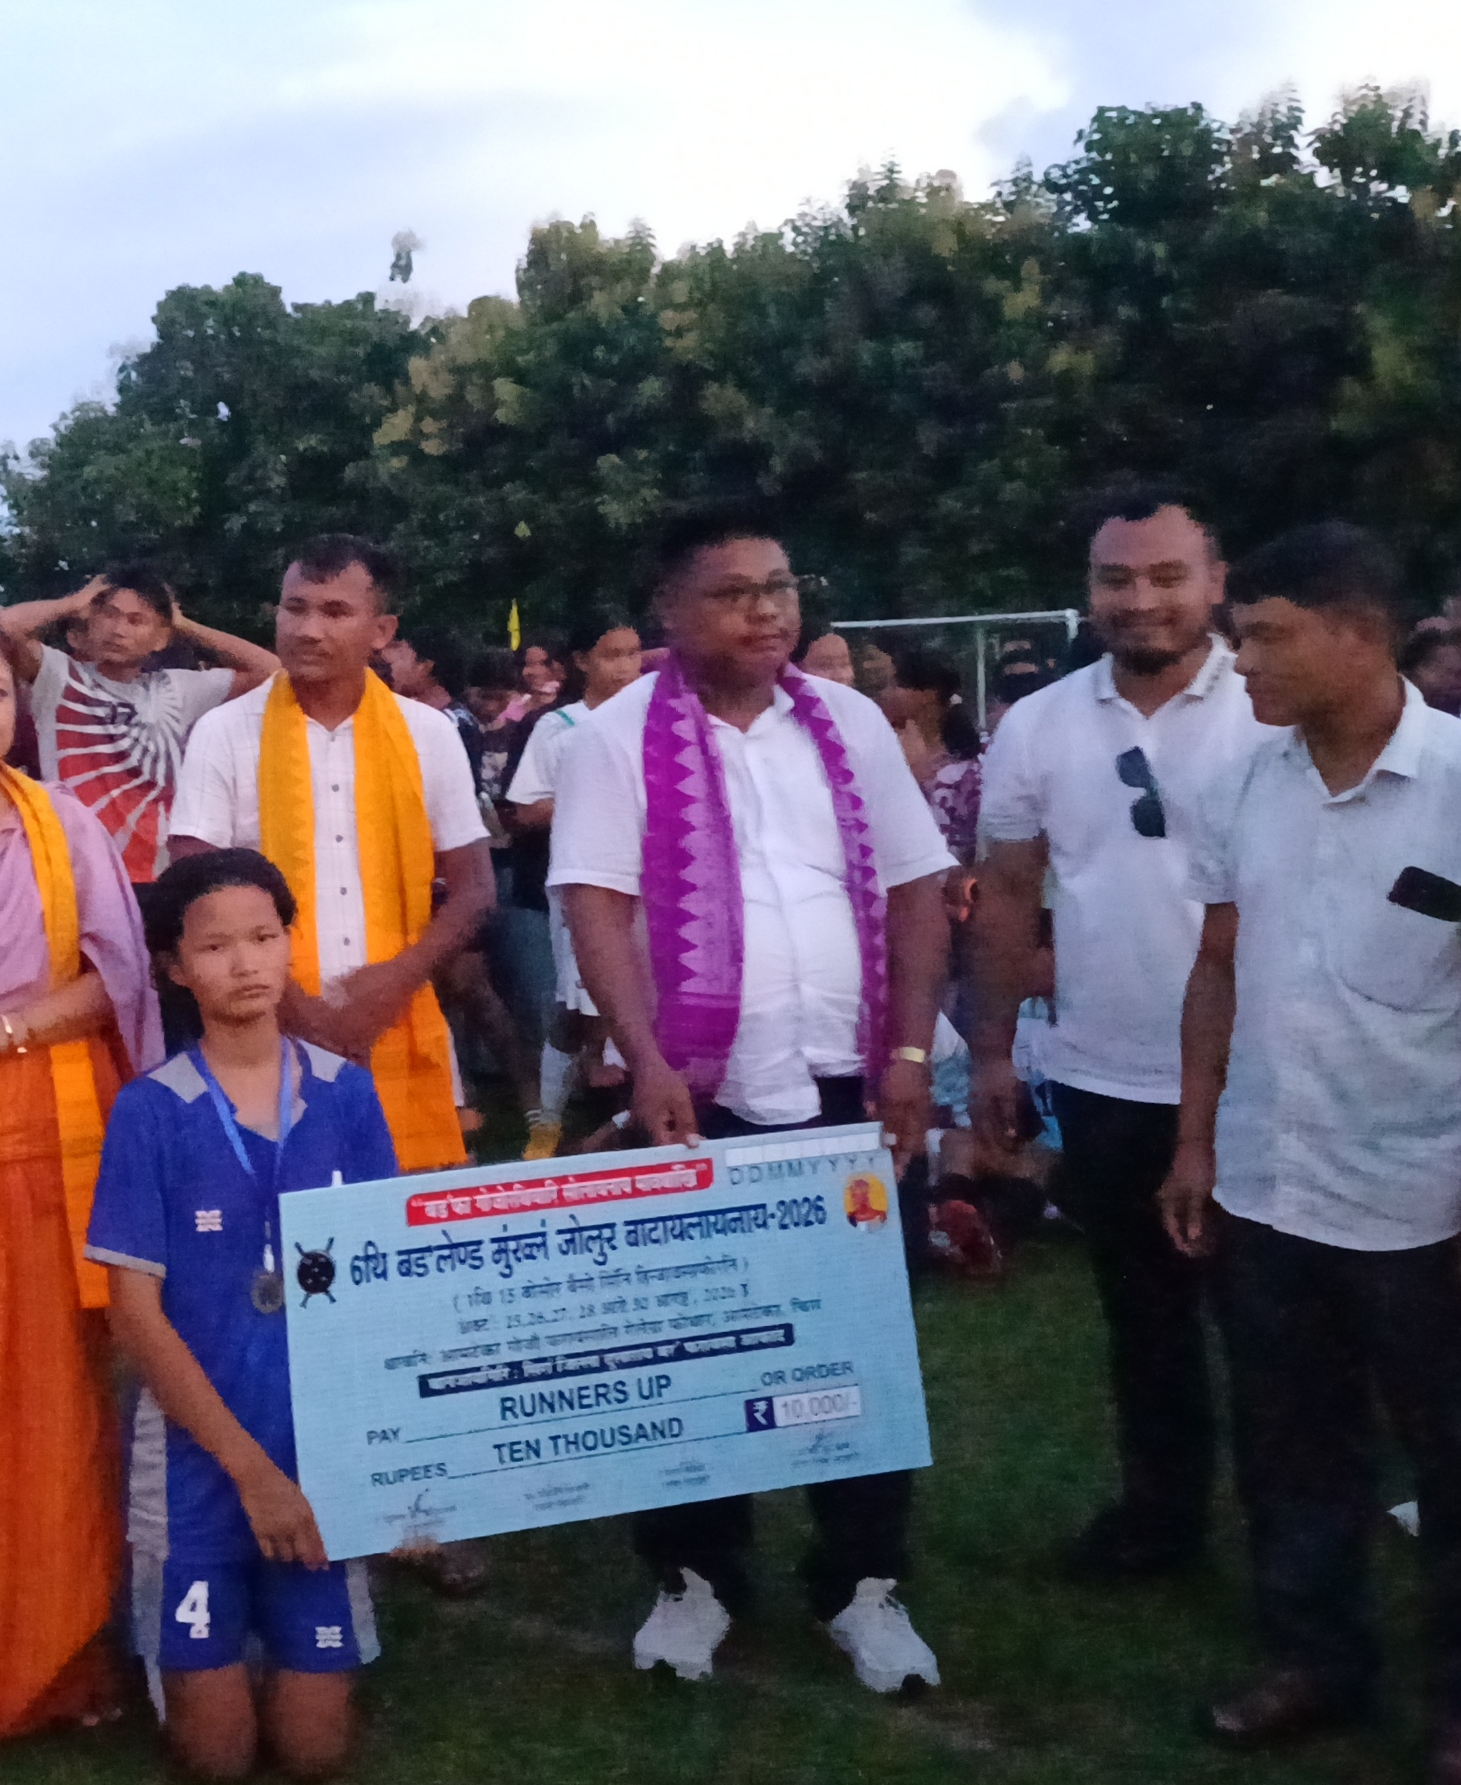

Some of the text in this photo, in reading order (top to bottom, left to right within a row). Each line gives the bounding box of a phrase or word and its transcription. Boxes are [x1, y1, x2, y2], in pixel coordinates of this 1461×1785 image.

[761, 1361, 855, 1387] OR ORDER
[499, 1374, 672, 1421] RUNNERS UP
[366, 1427, 401, 1446] PAY
[492, 1417, 684, 1465] TEN THOUSAND
[370, 1462, 448, 1487] RUPEES
[175, 1580, 211, 1639] 4
